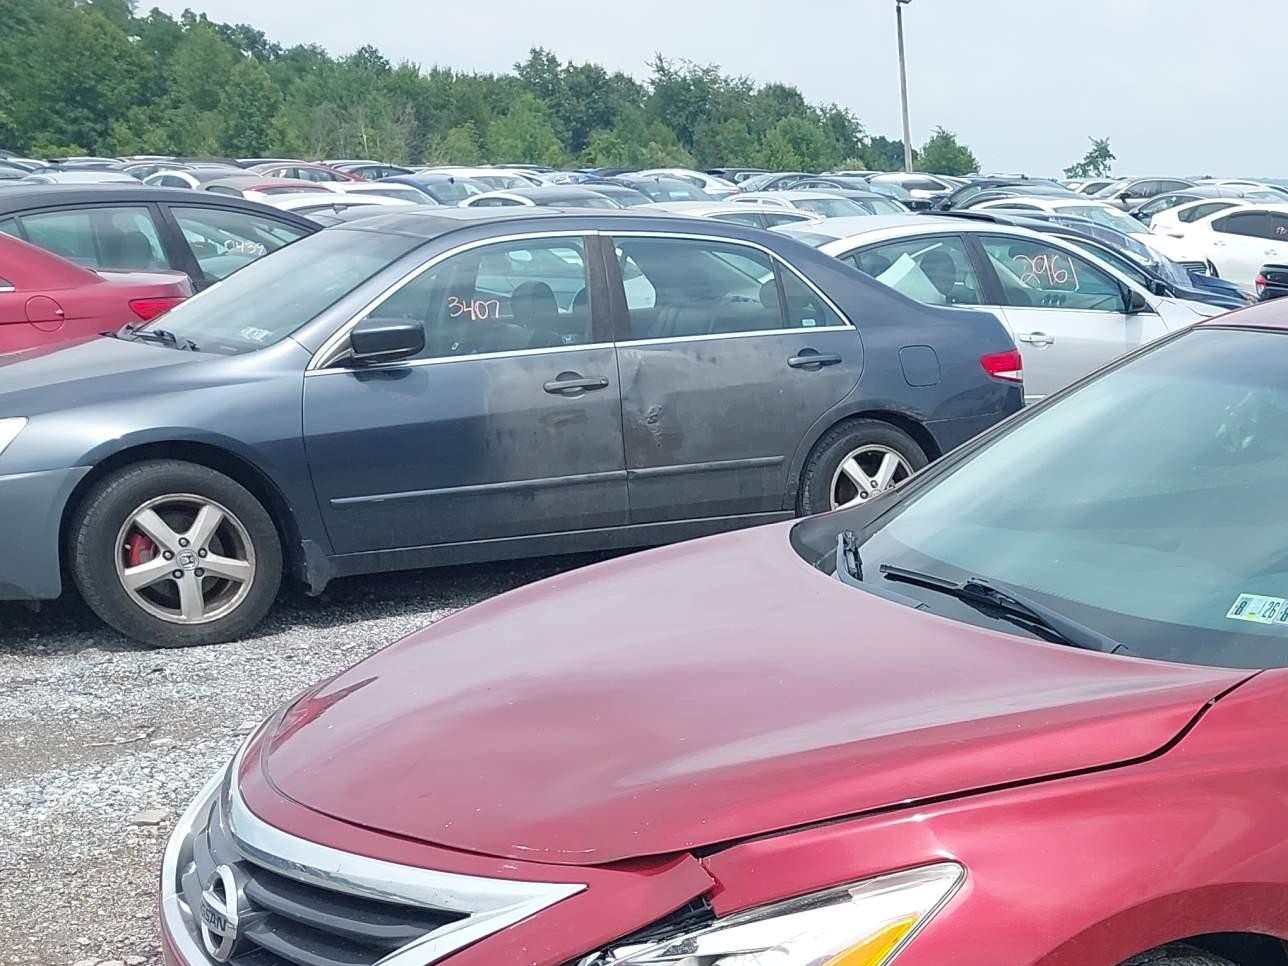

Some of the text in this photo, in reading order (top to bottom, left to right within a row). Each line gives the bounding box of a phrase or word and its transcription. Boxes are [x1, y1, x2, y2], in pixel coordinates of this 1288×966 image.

[1012, 254, 1080, 291] 2961
[448, 296, 500, 320] 3407
[1262, 601, 1281, 619] 26
